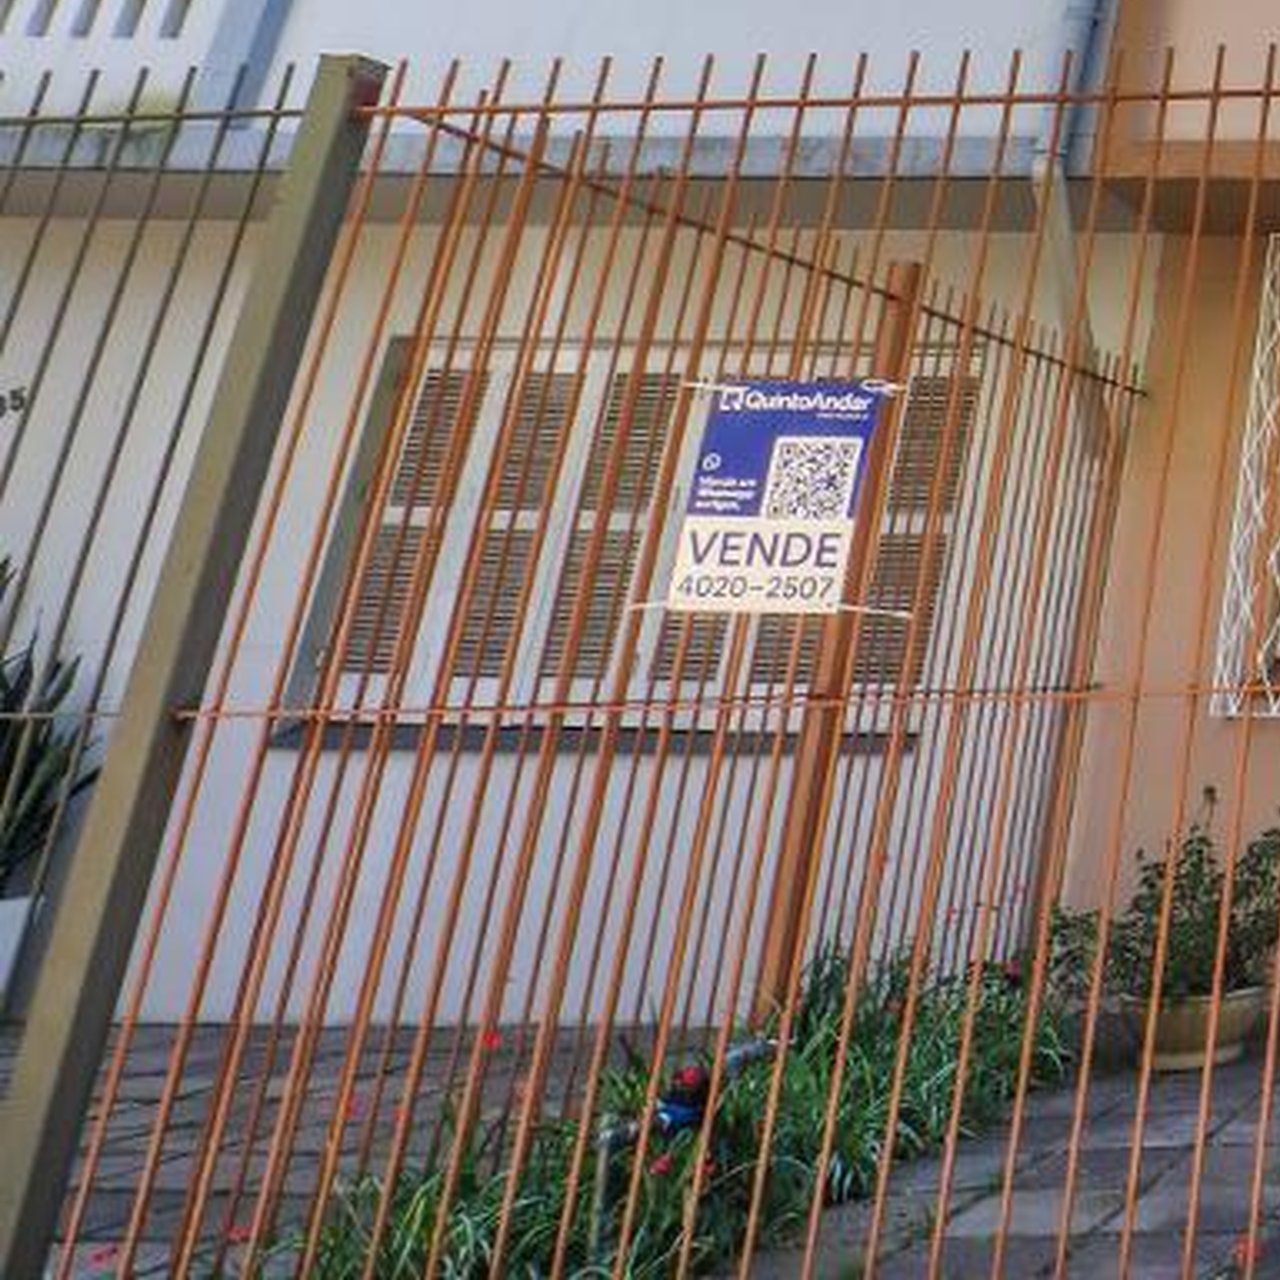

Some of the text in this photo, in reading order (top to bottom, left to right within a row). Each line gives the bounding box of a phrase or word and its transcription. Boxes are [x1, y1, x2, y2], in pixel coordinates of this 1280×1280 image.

[745, 390, 872, 412] QuintoAndar
[689, 531, 843, 568] VENDE
[676, 575, 835, 600] 4020-2507
